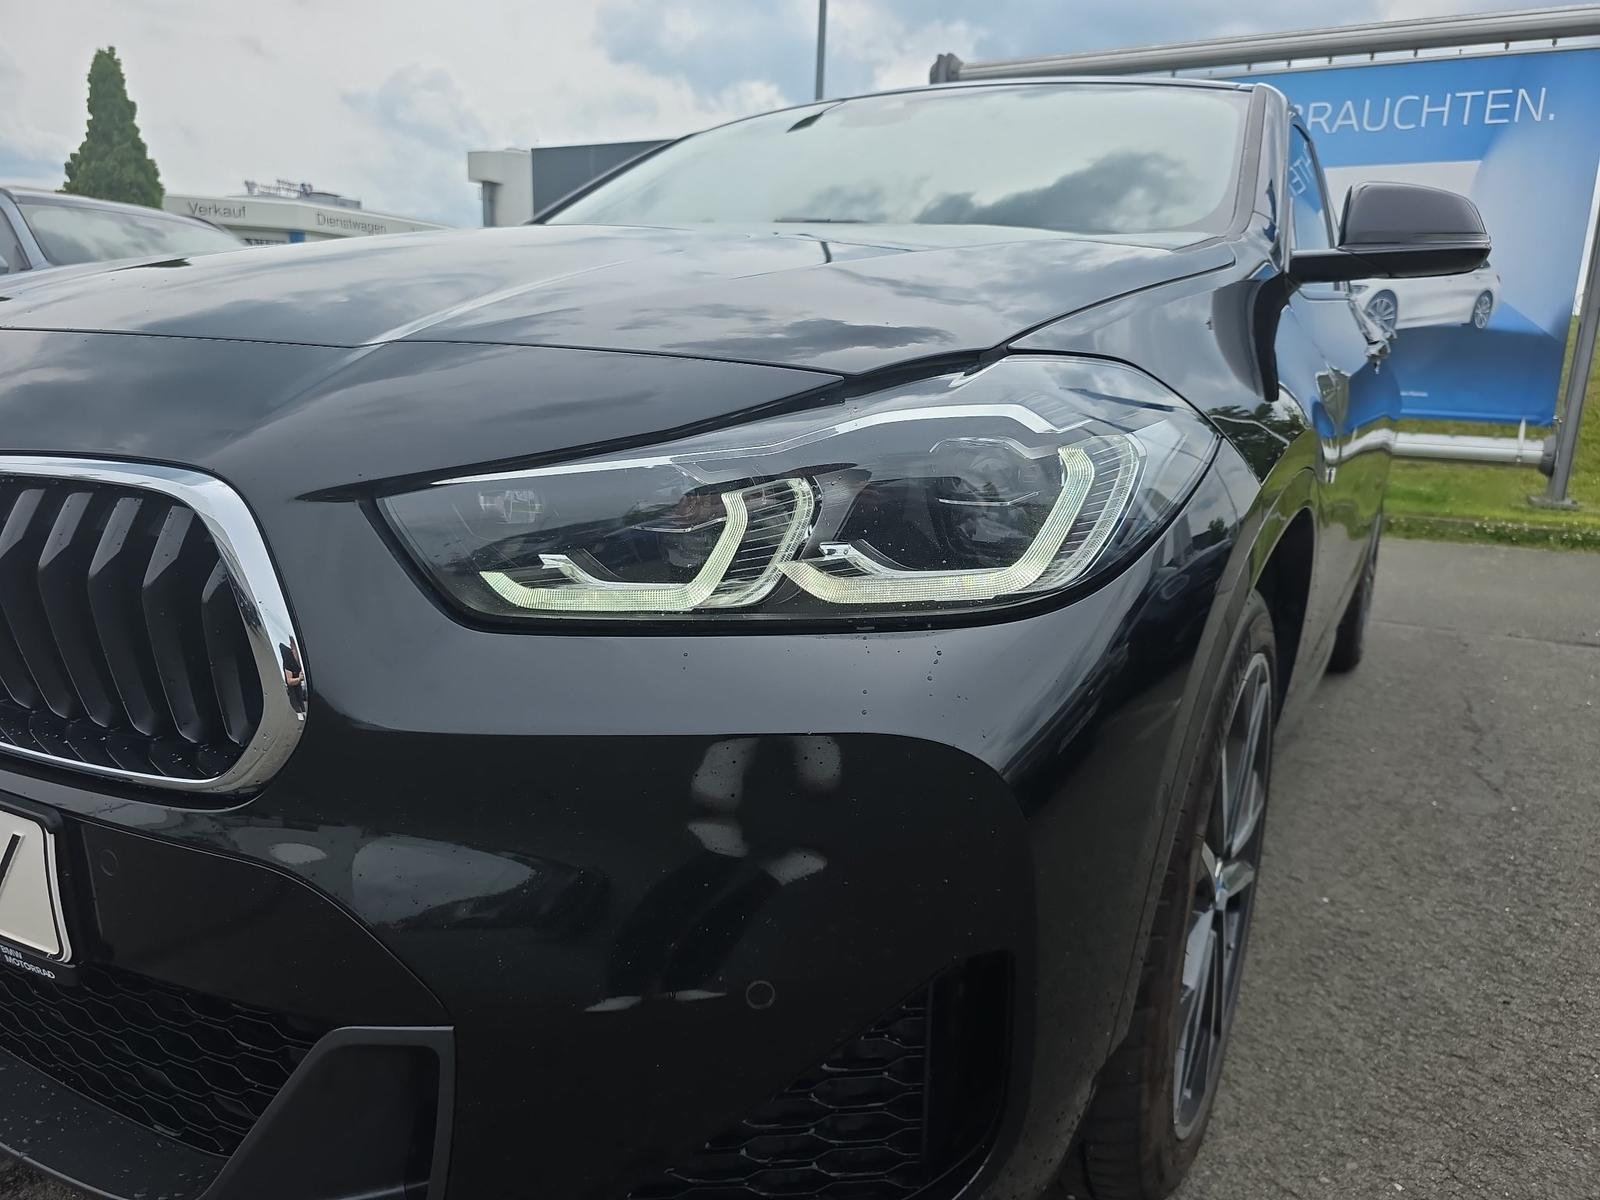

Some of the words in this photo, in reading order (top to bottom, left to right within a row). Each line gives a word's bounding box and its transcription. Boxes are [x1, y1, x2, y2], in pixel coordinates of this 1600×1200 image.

[187, 200, 247, 218] Verkauf
[315, 210, 387, 236] Dienstwagen
[4, 954, 56, 979] MOTORRAD
